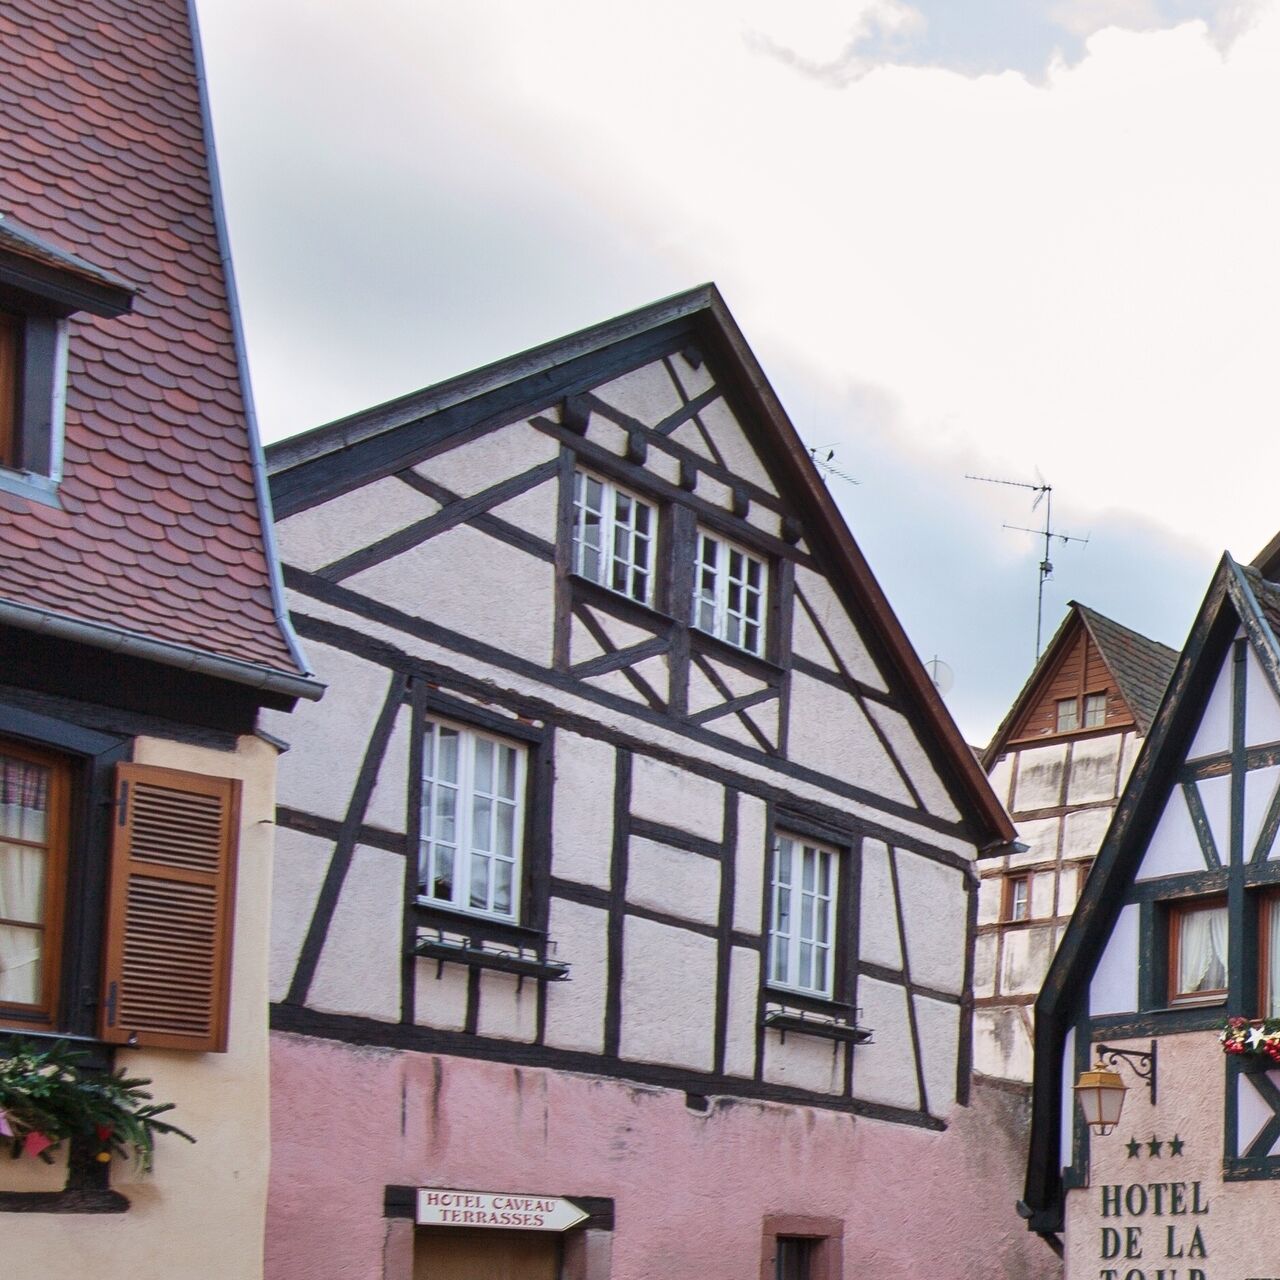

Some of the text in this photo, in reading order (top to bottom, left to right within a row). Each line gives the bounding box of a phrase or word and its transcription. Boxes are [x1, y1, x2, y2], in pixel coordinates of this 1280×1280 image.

[427, 1192, 556, 1213] HOTEL CAVEAU
[1100, 1181, 1210, 1217] HOTEL
[439, 1209, 545, 1227] TERRASSES
[1100, 1225, 1207, 1259] DE LA
